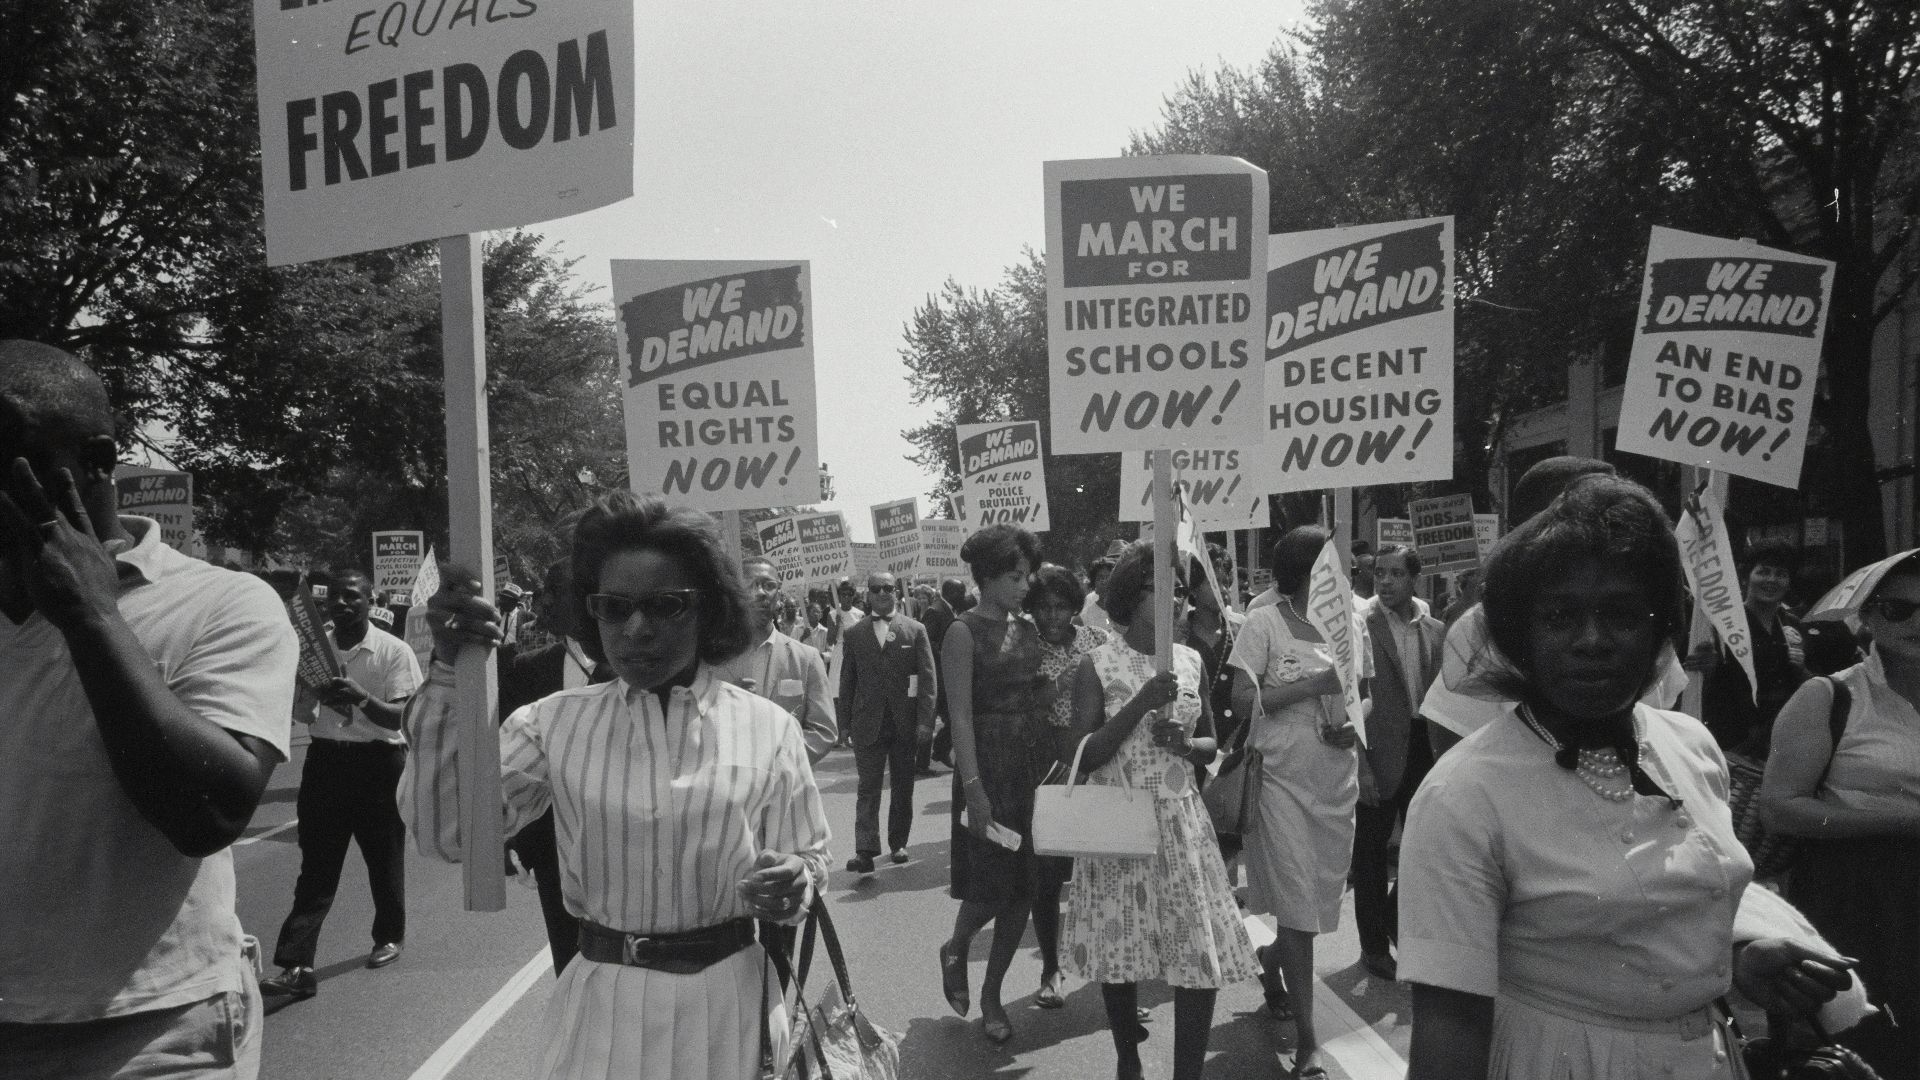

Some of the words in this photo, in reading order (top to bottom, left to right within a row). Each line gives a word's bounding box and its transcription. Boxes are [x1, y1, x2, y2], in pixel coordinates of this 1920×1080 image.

[345, 0, 537, 54] EQUALS
[286, 29, 616, 191] FREEDOM
[1130, 184, 1185, 212] WE
[1078, 217, 1237, 256] MARCH
[1128, 260, 1189, 277] FOR
[1314, 243, 1382, 293] WE
[1706, 261, 1773, 291] WE
[683, 279, 745, 322] WE
[1065, 292, 1250, 330] INTEGRATED
[1267, 266, 1438, 349] DEMAND
[1656, 293, 1815, 326] DEMAND
[640, 305, 797, 372] DEMAND
[1066, 339, 1248, 376] SCHOOLS
[1284, 347, 1427, 387] DECENT
[1656, 340, 1712, 372] AN
[1725, 352, 1803, 390] END
[658, 380, 788, 410] EQUAL
[1080, 378, 1241, 433] NOW!
[1656, 372, 1702, 403] TO
[1713, 383, 1795, 423] BIAS
[1270, 389, 1441, 430] HOUSING
[658, 415, 795, 448] RIGHTS
[986, 428, 1013, 449] WE
[1648, 407, 1791, 462] NOW!
[969, 439, 1034, 472] DEMAND
[1282, 418, 1433, 472] NOW!
[663, 446, 801, 495] NOW!
[1144, 450, 1239, 470] GHTS
[140, 477, 166, 489] WE
[975, 473, 997, 484] AN
[1003, 471, 1031, 481] END
[1142, 474, 1241, 506] W!
[122, 488, 186, 506] DEMAND
[979, 496, 1031, 509] BRUTALITY
[989, 486, 1023, 497] POLICE
[813, 518, 826, 526] WE
[881, 513, 913, 529] MARCH
[890, 507, 900, 516] WE
[980, 503, 1040, 526] NOW!
[1415, 512, 1452, 528] JOBS
[775, 520, 791, 534] WE
[803, 523, 839, 537] MARCH
[1417, 526, 1473, 546] FREEDOM
[766, 531, 796, 550] DEMA
[771, 549, 784, 557] AN
[803, 540, 846, 554] INTEGRATED
[880, 538, 898, 549] FIRST
[900, 533, 919, 544] CLASS
[880, 543, 920, 559] CITIZENSHIP
[804, 551, 848, 565] SCHOOLS
[811, 560, 848, 577] NOW!
[888, 554, 920, 573] NOW!
[380, 576, 418, 586] NOW!
[292, 594, 312, 634] MARCH
[1309, 563, 1351, 667] FREEDOM
[1722, 616, 1735, 629] IN
